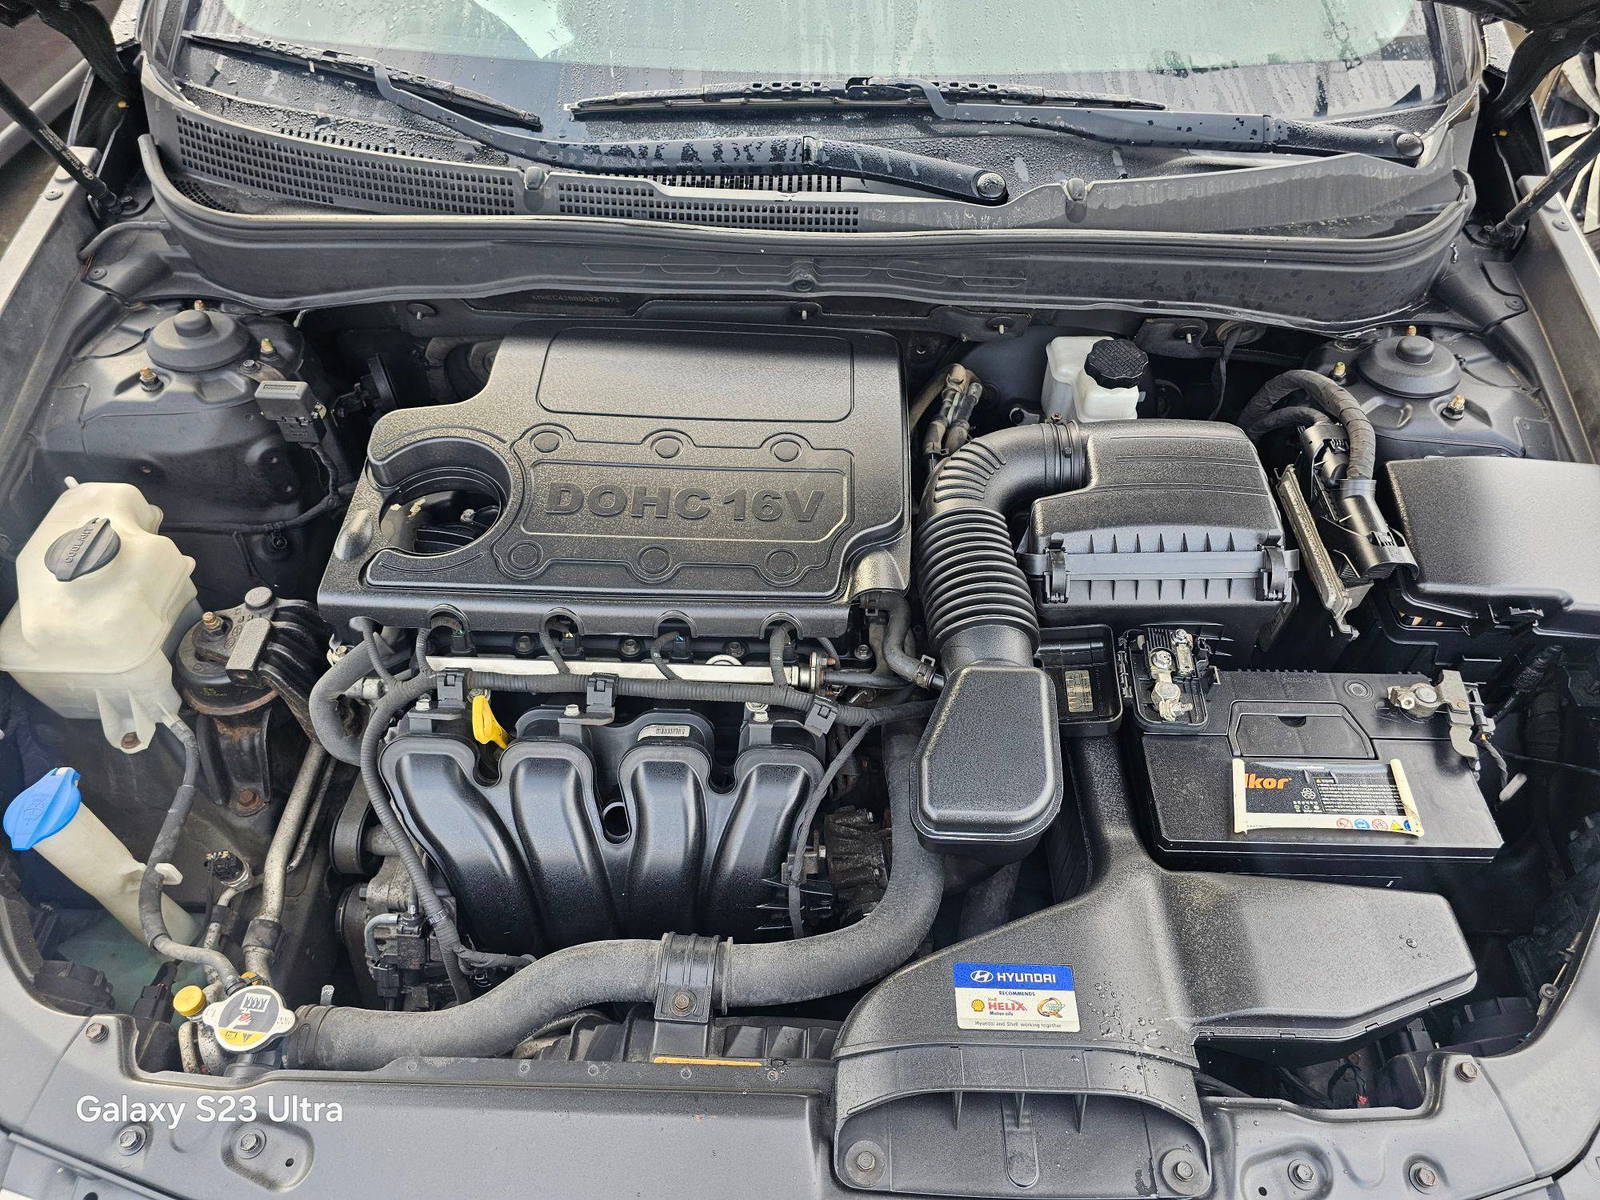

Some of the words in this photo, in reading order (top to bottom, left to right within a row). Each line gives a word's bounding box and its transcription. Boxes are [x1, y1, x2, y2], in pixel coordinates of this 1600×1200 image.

[545, 482, 711, 520] DOHC
[723, 488, 825, 522] 16V
[996, 972, 1057, 984] HYUNDAI
